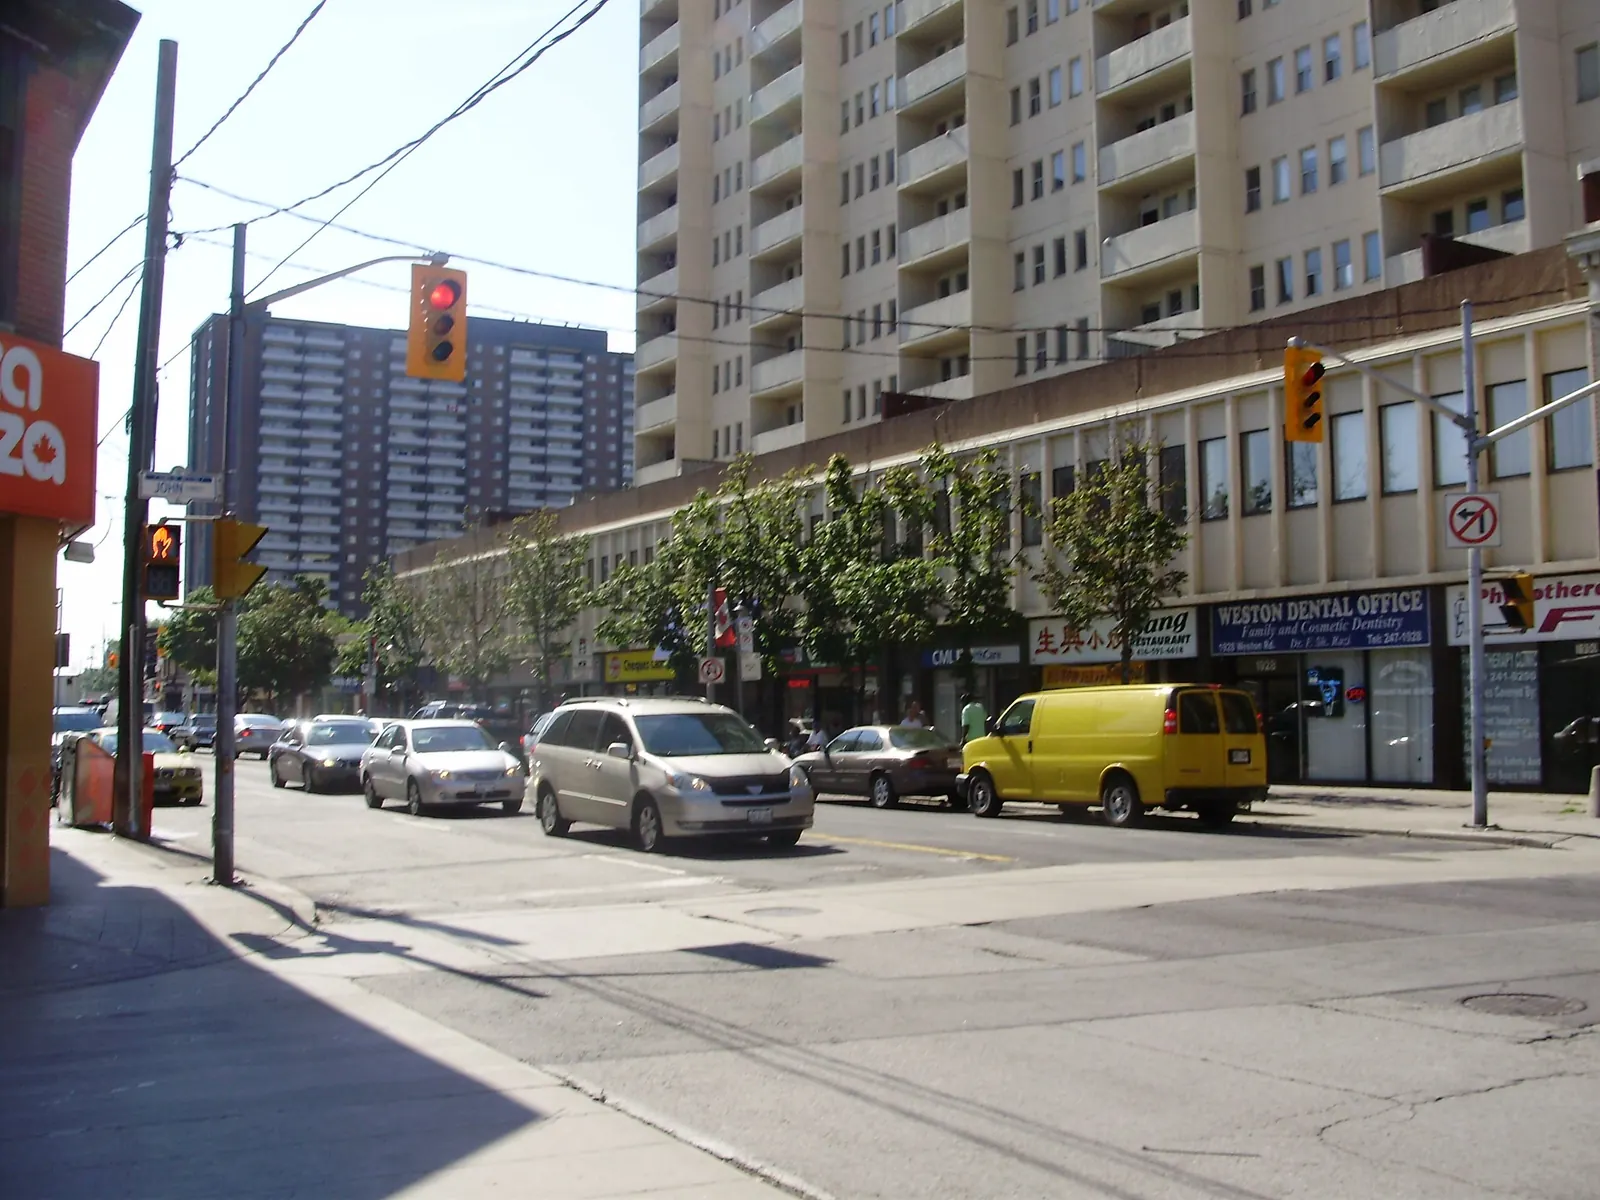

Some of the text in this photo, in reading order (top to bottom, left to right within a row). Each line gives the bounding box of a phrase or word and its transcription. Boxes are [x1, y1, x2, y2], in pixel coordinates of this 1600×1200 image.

[0, 345, 43, 412] a
[155, 481, 183, 494] JOHN
[1218, 590, 1423, 626] WESTON DENTAL OFFICE
[1138, 611, 1189, 636] ang
[1242, 615, 1404, 639] Family and Cosmetic Dentistry
